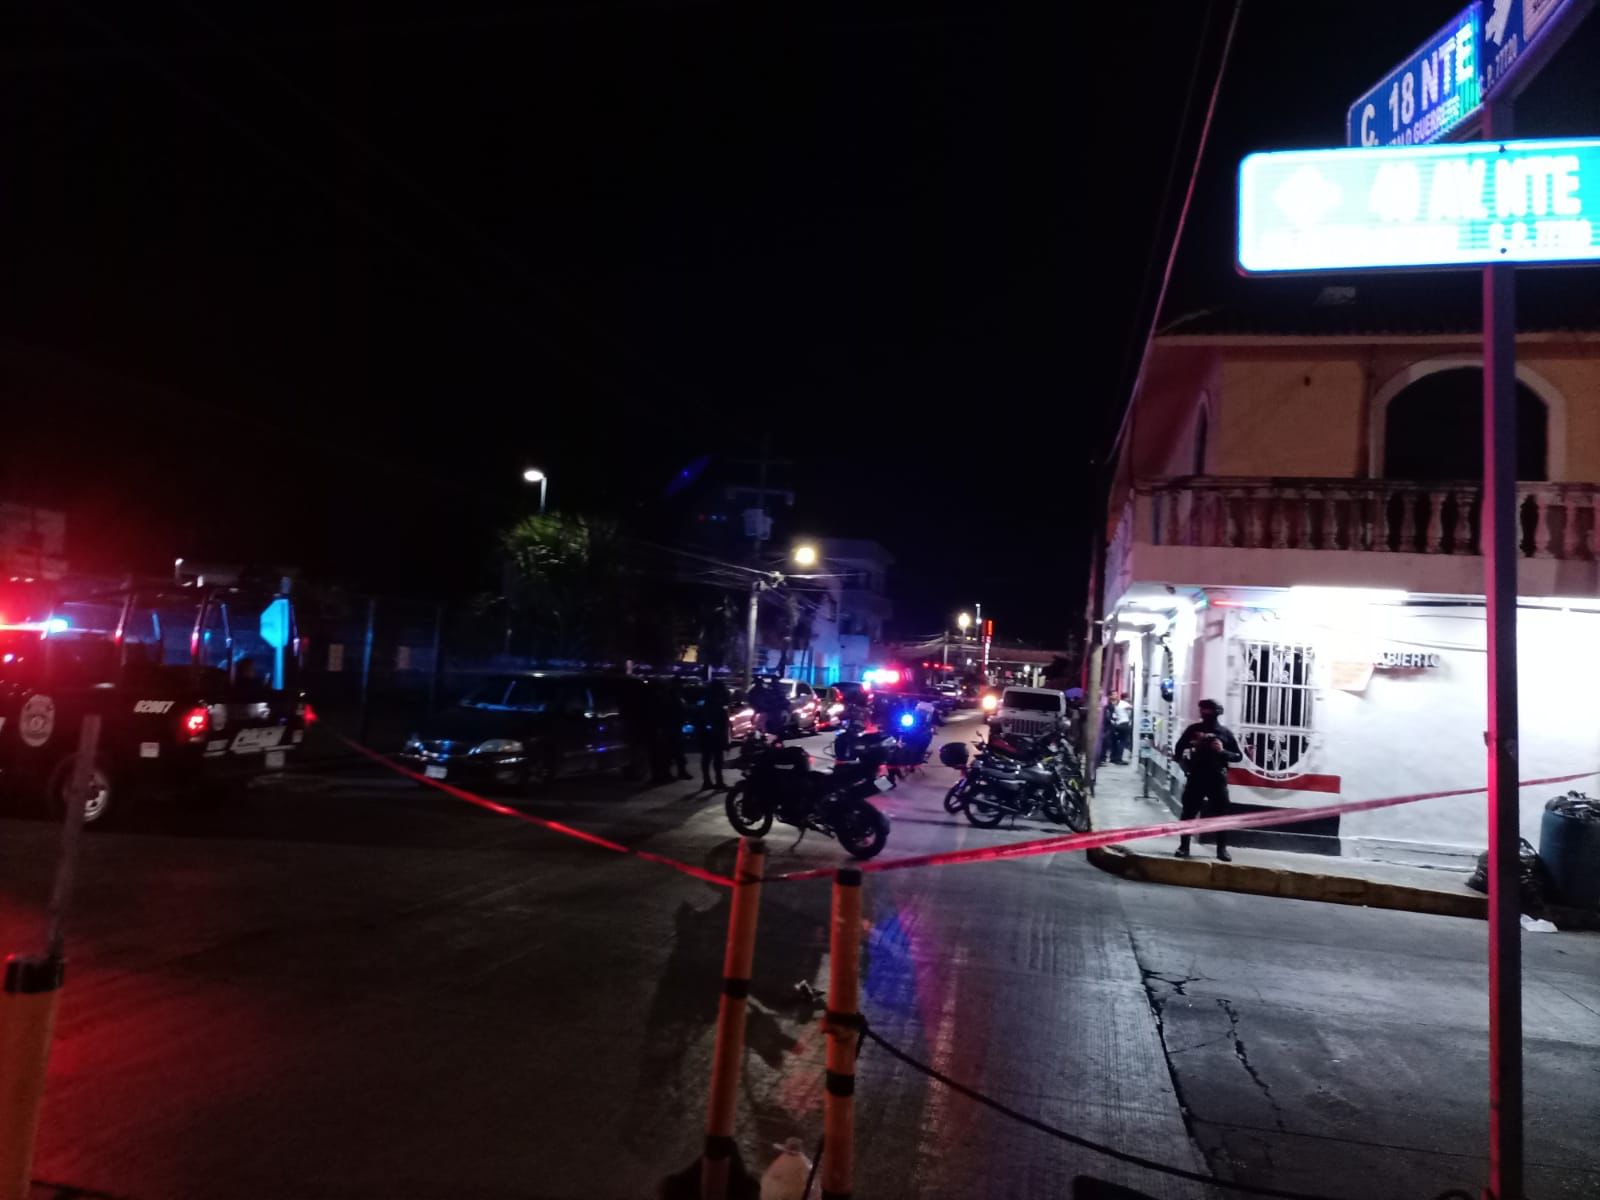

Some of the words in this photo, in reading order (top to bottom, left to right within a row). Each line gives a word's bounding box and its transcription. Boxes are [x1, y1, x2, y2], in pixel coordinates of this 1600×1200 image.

[1388, 71, 1415, 132] 18
[1421, 22, 1473, 111] NTE
[1494, 155, 1582, 217] NTE
[1374, 651, 1441, 668] ABIERTO
